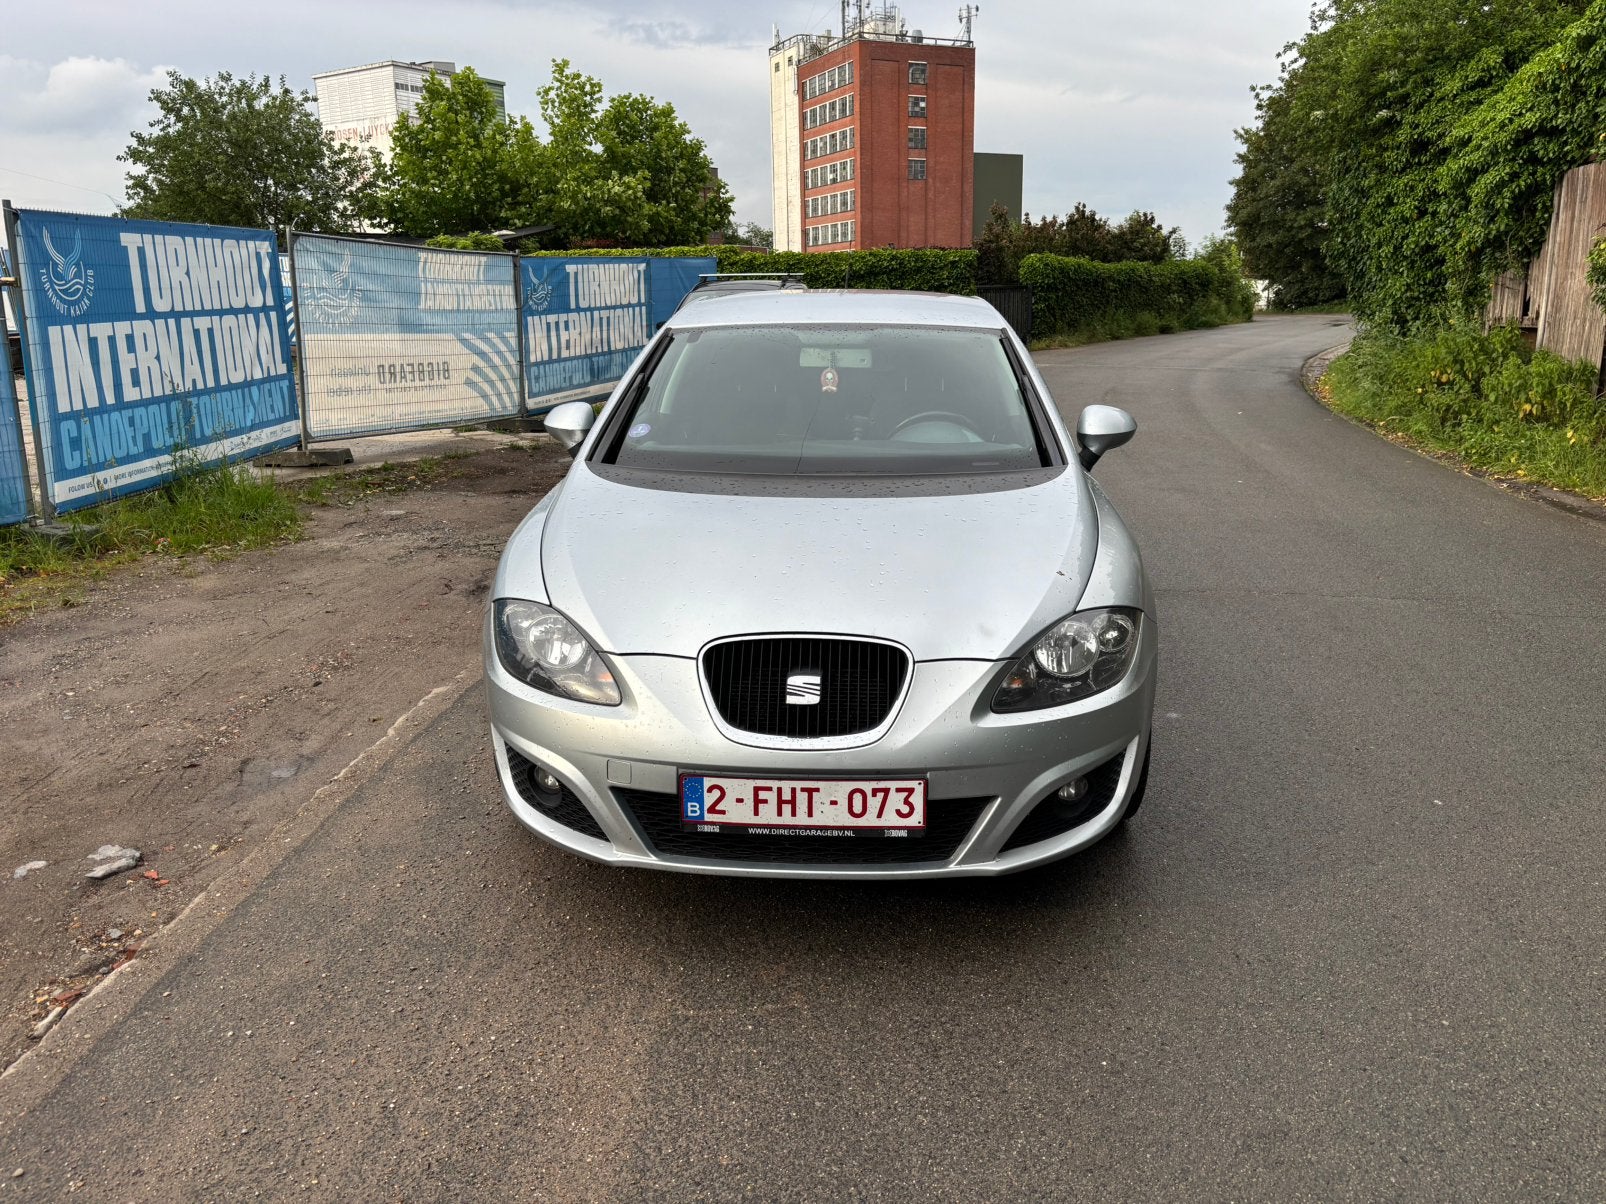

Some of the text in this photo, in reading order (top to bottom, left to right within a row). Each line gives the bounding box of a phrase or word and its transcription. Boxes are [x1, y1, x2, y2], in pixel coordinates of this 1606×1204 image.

[40, 268, 95, 317] TURNHOUT KAJAK CLUB
[119, 232, 275, 314] TURNHOUT
[565, 263, 647, 309] TURNHOUT
[527, 306, 650, 363] INTERNATIONAL
[48, 311, 287, 413] INTERNATIONAL
[530, 358, 591, 394] CANOEPOLO
[60, 379, 290, 470] CANOEPOLO TOURNAMENT
[687, 784, 916, 819] B 2-FHT-073
[748, 827, 856, 837] WWW.DIRECTGARAGEBV.NL
